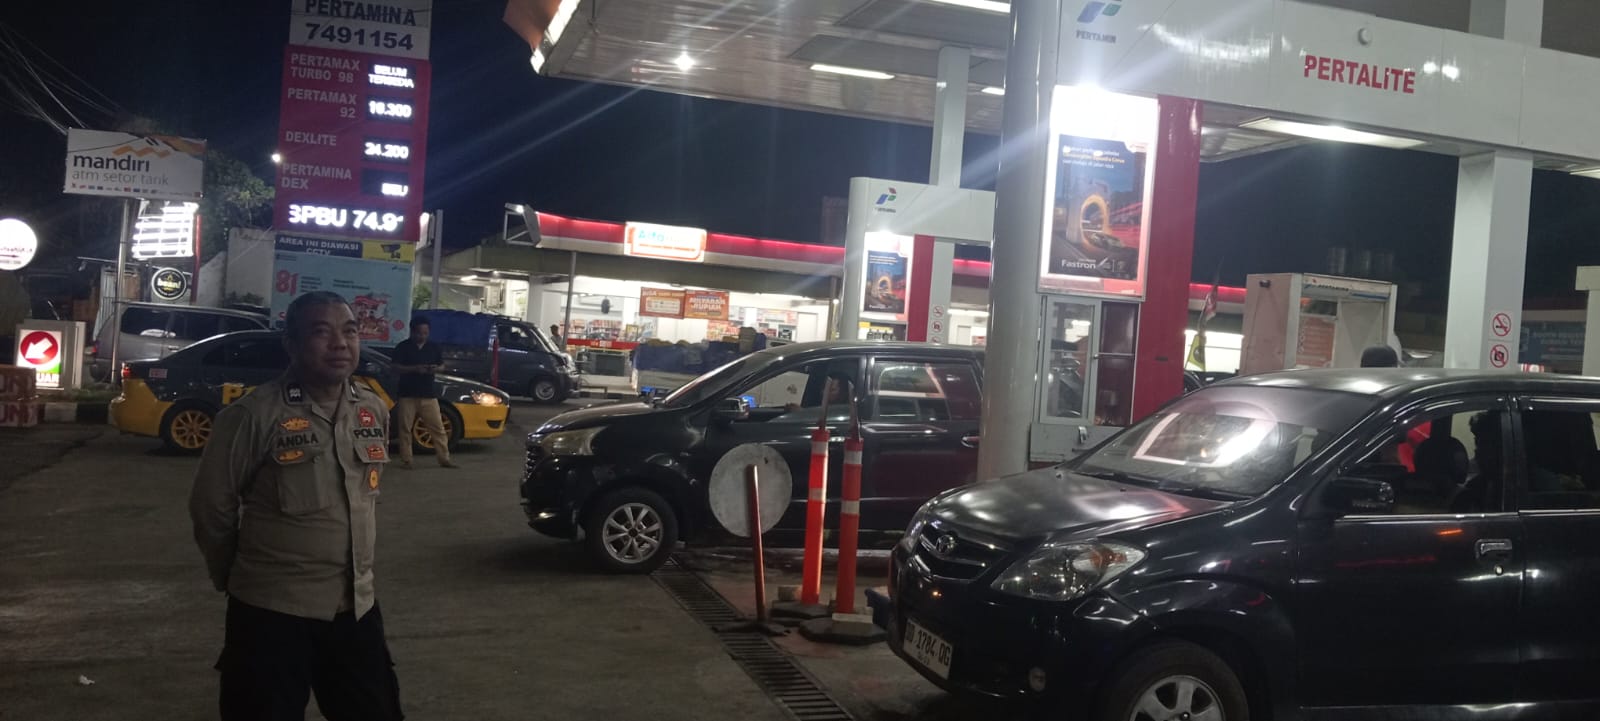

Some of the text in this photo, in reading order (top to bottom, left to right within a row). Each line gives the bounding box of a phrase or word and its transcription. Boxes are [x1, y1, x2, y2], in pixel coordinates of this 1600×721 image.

[306, 0, 417, 27] PERTAMINA
[306, 22, 414, 50] 7491154
[291, 53, 361, 71] PERTAMAX
[291, 66, 354, 84] TURBO 98
[1304, 54, 1416, 94] PERTALITE
[288, 88, 357, 105] PERTAMAX
[340, 107, 356, 119] 92
[285, 131, 337, 146] DEXLITE
[73, 154, 150, 173] mandiri
[281, 163, 353, 180] PERTAMINA
[72, 170, 100, 181] atm
[103, 171, 137, 184] setor
[281, 177, 309, 190] DEX
[279, 237, 359, 250] AREA INI DIAWASI
[305, 247, 331, 256] CCTV
[1061, 258, 1096, 270] Fastron
[276, 432, 320, 449] ANDLA
[916, 629, 937, 657] 1784
